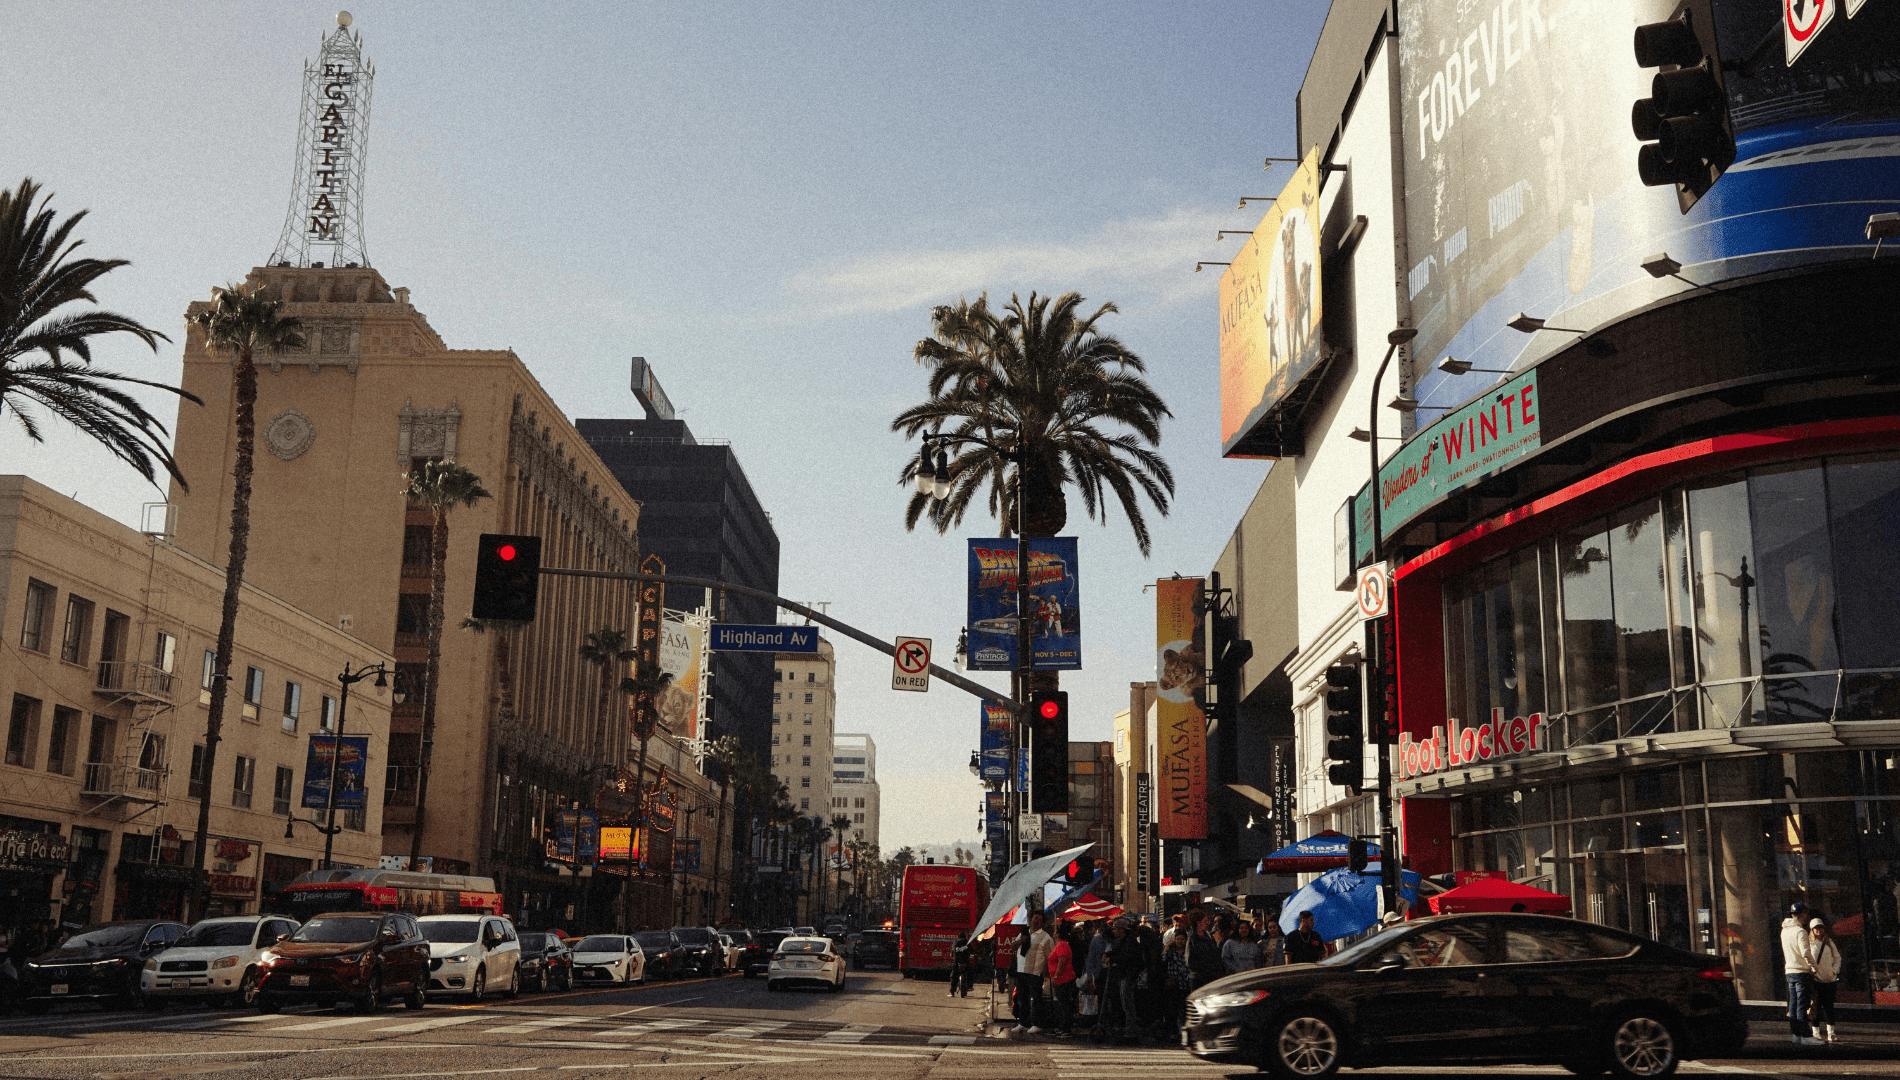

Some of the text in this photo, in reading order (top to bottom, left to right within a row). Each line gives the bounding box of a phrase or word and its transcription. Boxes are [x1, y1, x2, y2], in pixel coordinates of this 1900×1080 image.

[324, 64, 347, 77] EL
[309, 82, 343, 233] CAPITAN
[1489, 180, 1524, 240] PUMA
[1444, 226, 1468, 267] PUMA
[1221, 271, 1263, 334] MUFASA
[1382, 384, 1535, 510] Wonders of WINTE
[1447, 470, 1463, 483] LEARN
[1482, 430, 1540, 465] OVATIONHOLLYWOOD
[973, 547, 1051, 568] BACK
[981, 565, 1063, 586] TO FUTURE
[660, 631, 690, 650] FASA
[719, 629, 808, 648] Highland Av
[976, 651, 1009, 660] PANTAGES
[895, 676, 926, 687] ON RED
[1399, 707, 1543, 779] Foot Locker
[1161, 754, 1170, 778] Disney
[1171, 718, 1190, 817] MUFASA
[1192, 716, 1201, 817] THE LION KING
[1138, 779, 1148, 867] DOLBY THEATRE
[1275, 807, 1281, 820] VR
[1296, 844, 1349, 852] Starli
[293, 892, 307, 901] 217
